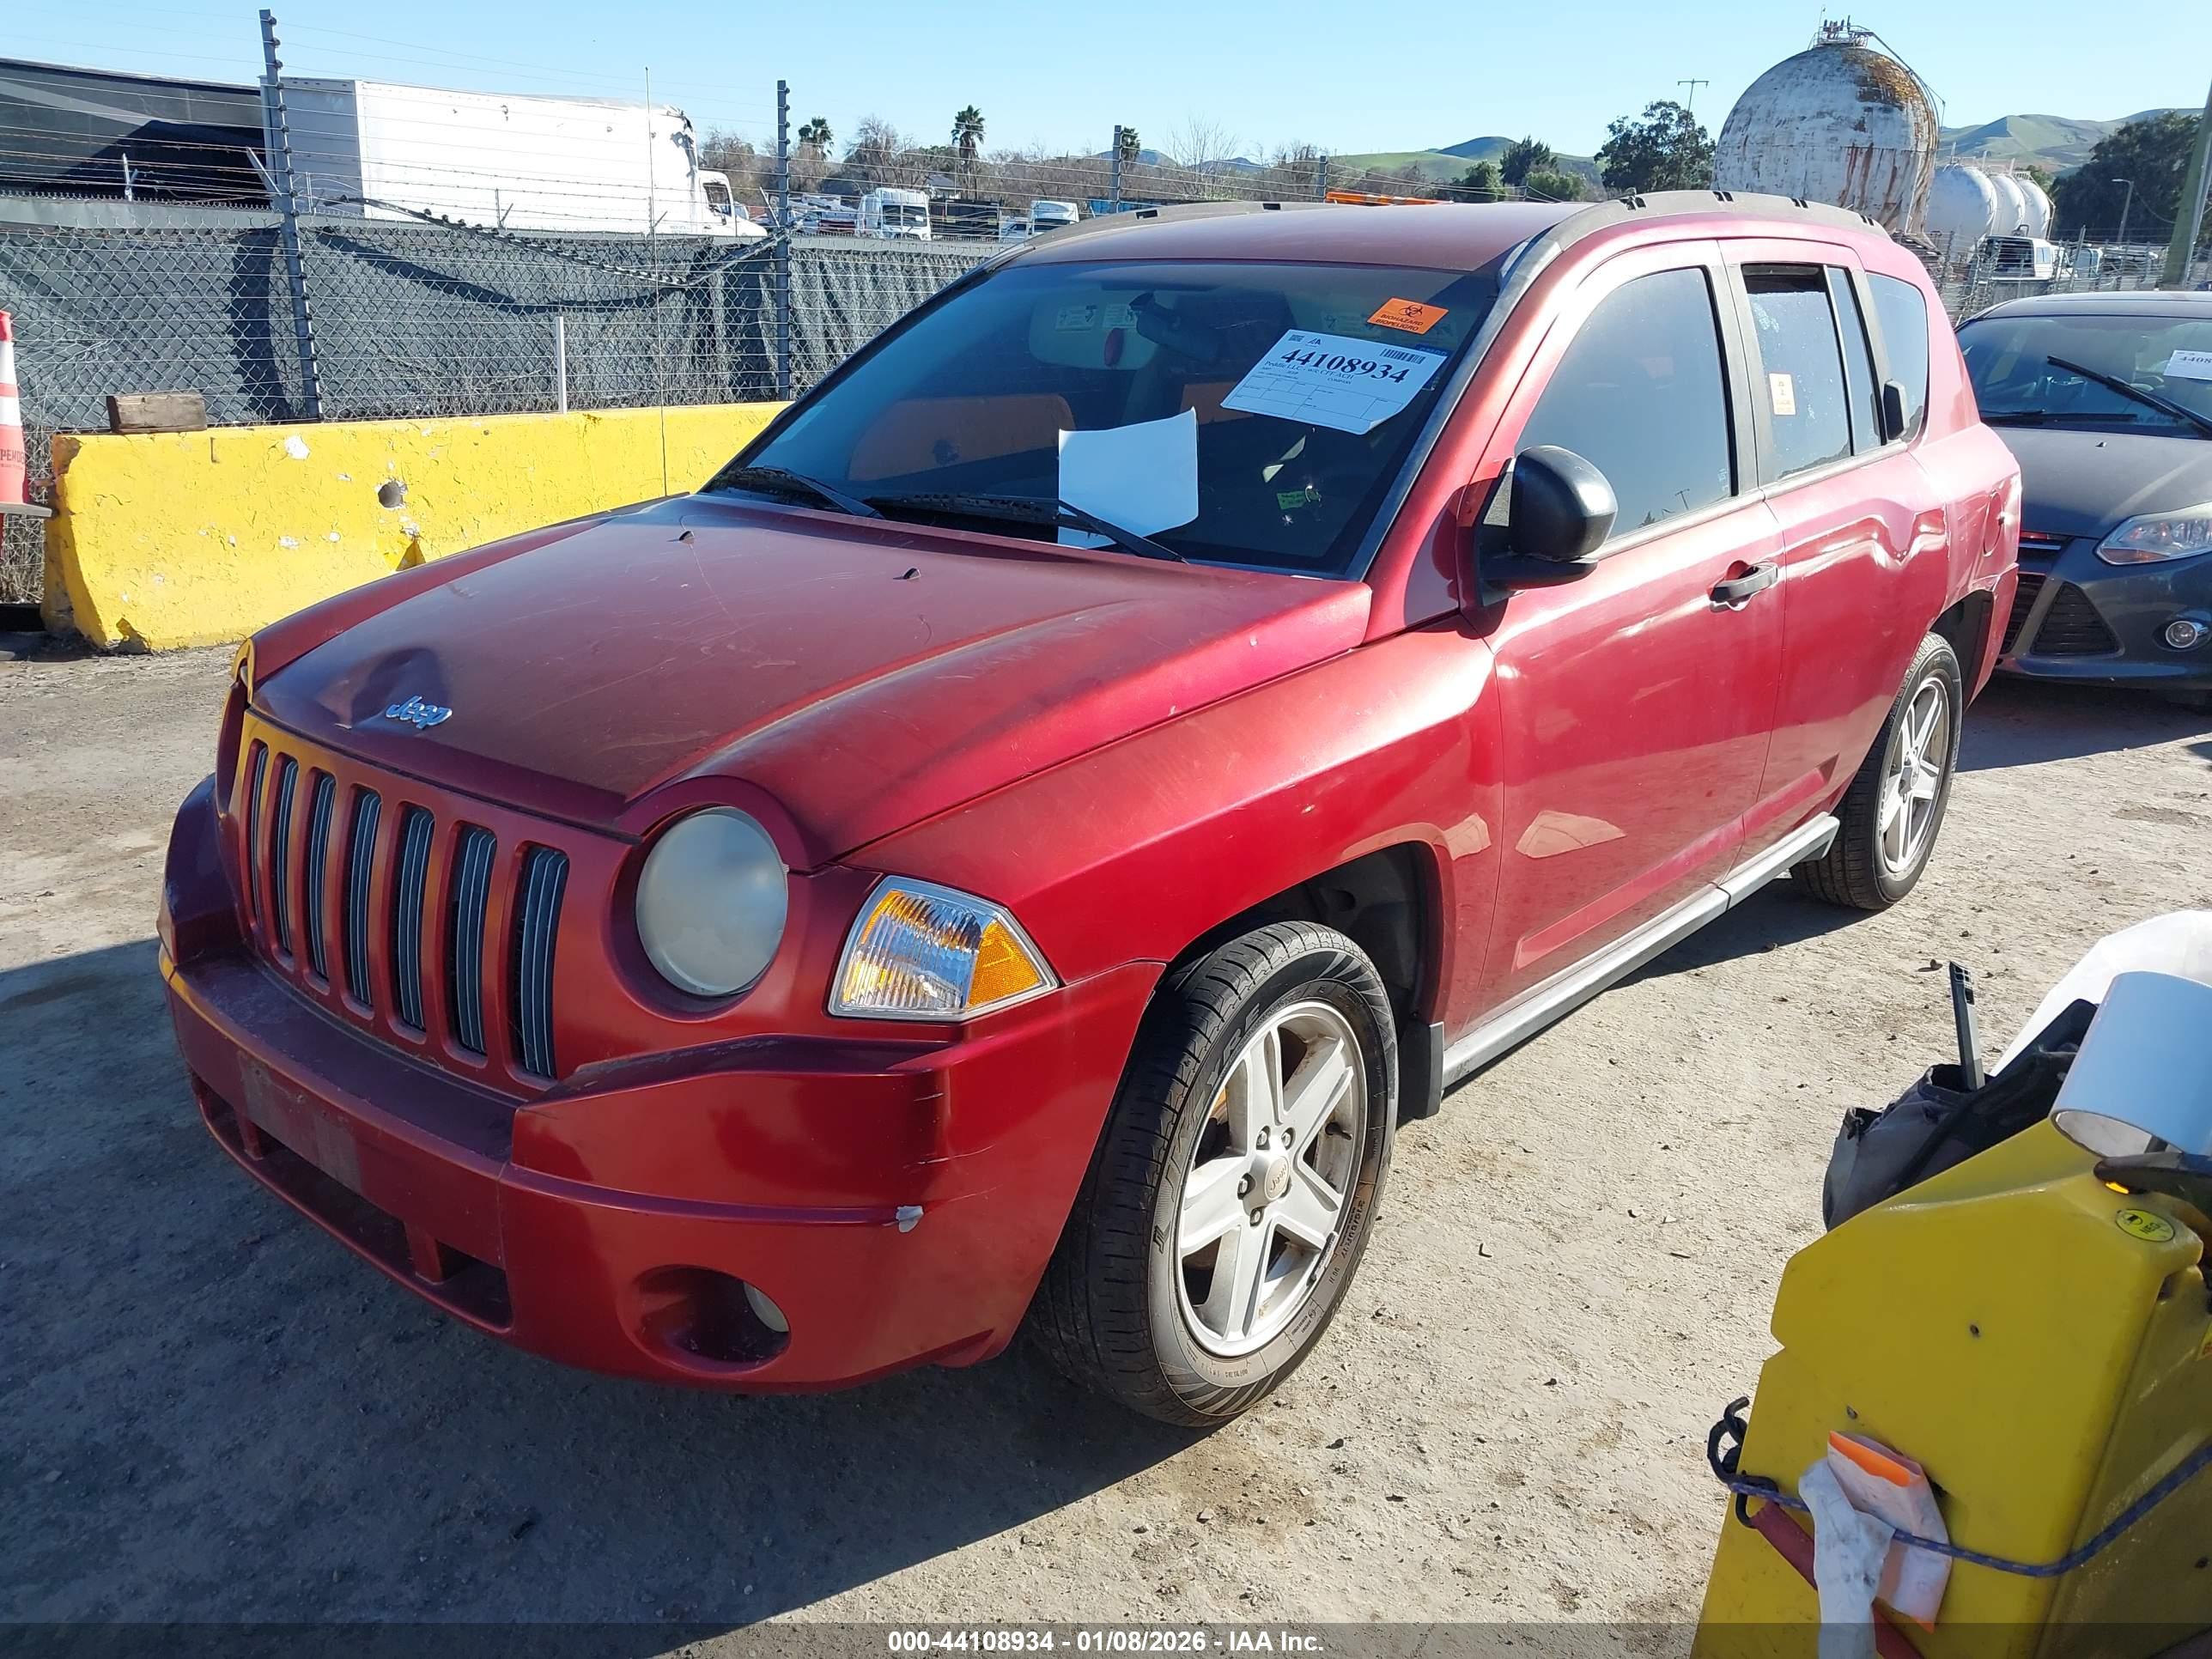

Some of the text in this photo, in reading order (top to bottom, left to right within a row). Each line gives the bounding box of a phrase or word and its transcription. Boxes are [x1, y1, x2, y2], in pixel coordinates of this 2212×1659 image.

[1376, 319, 1419, 331] BIOPELIGRO
[1381, 313, 1424, 326] BIOHAZARD
[1280, 349, 1411, 384] 44108934
[386, 695, 453, 729] Jeep
